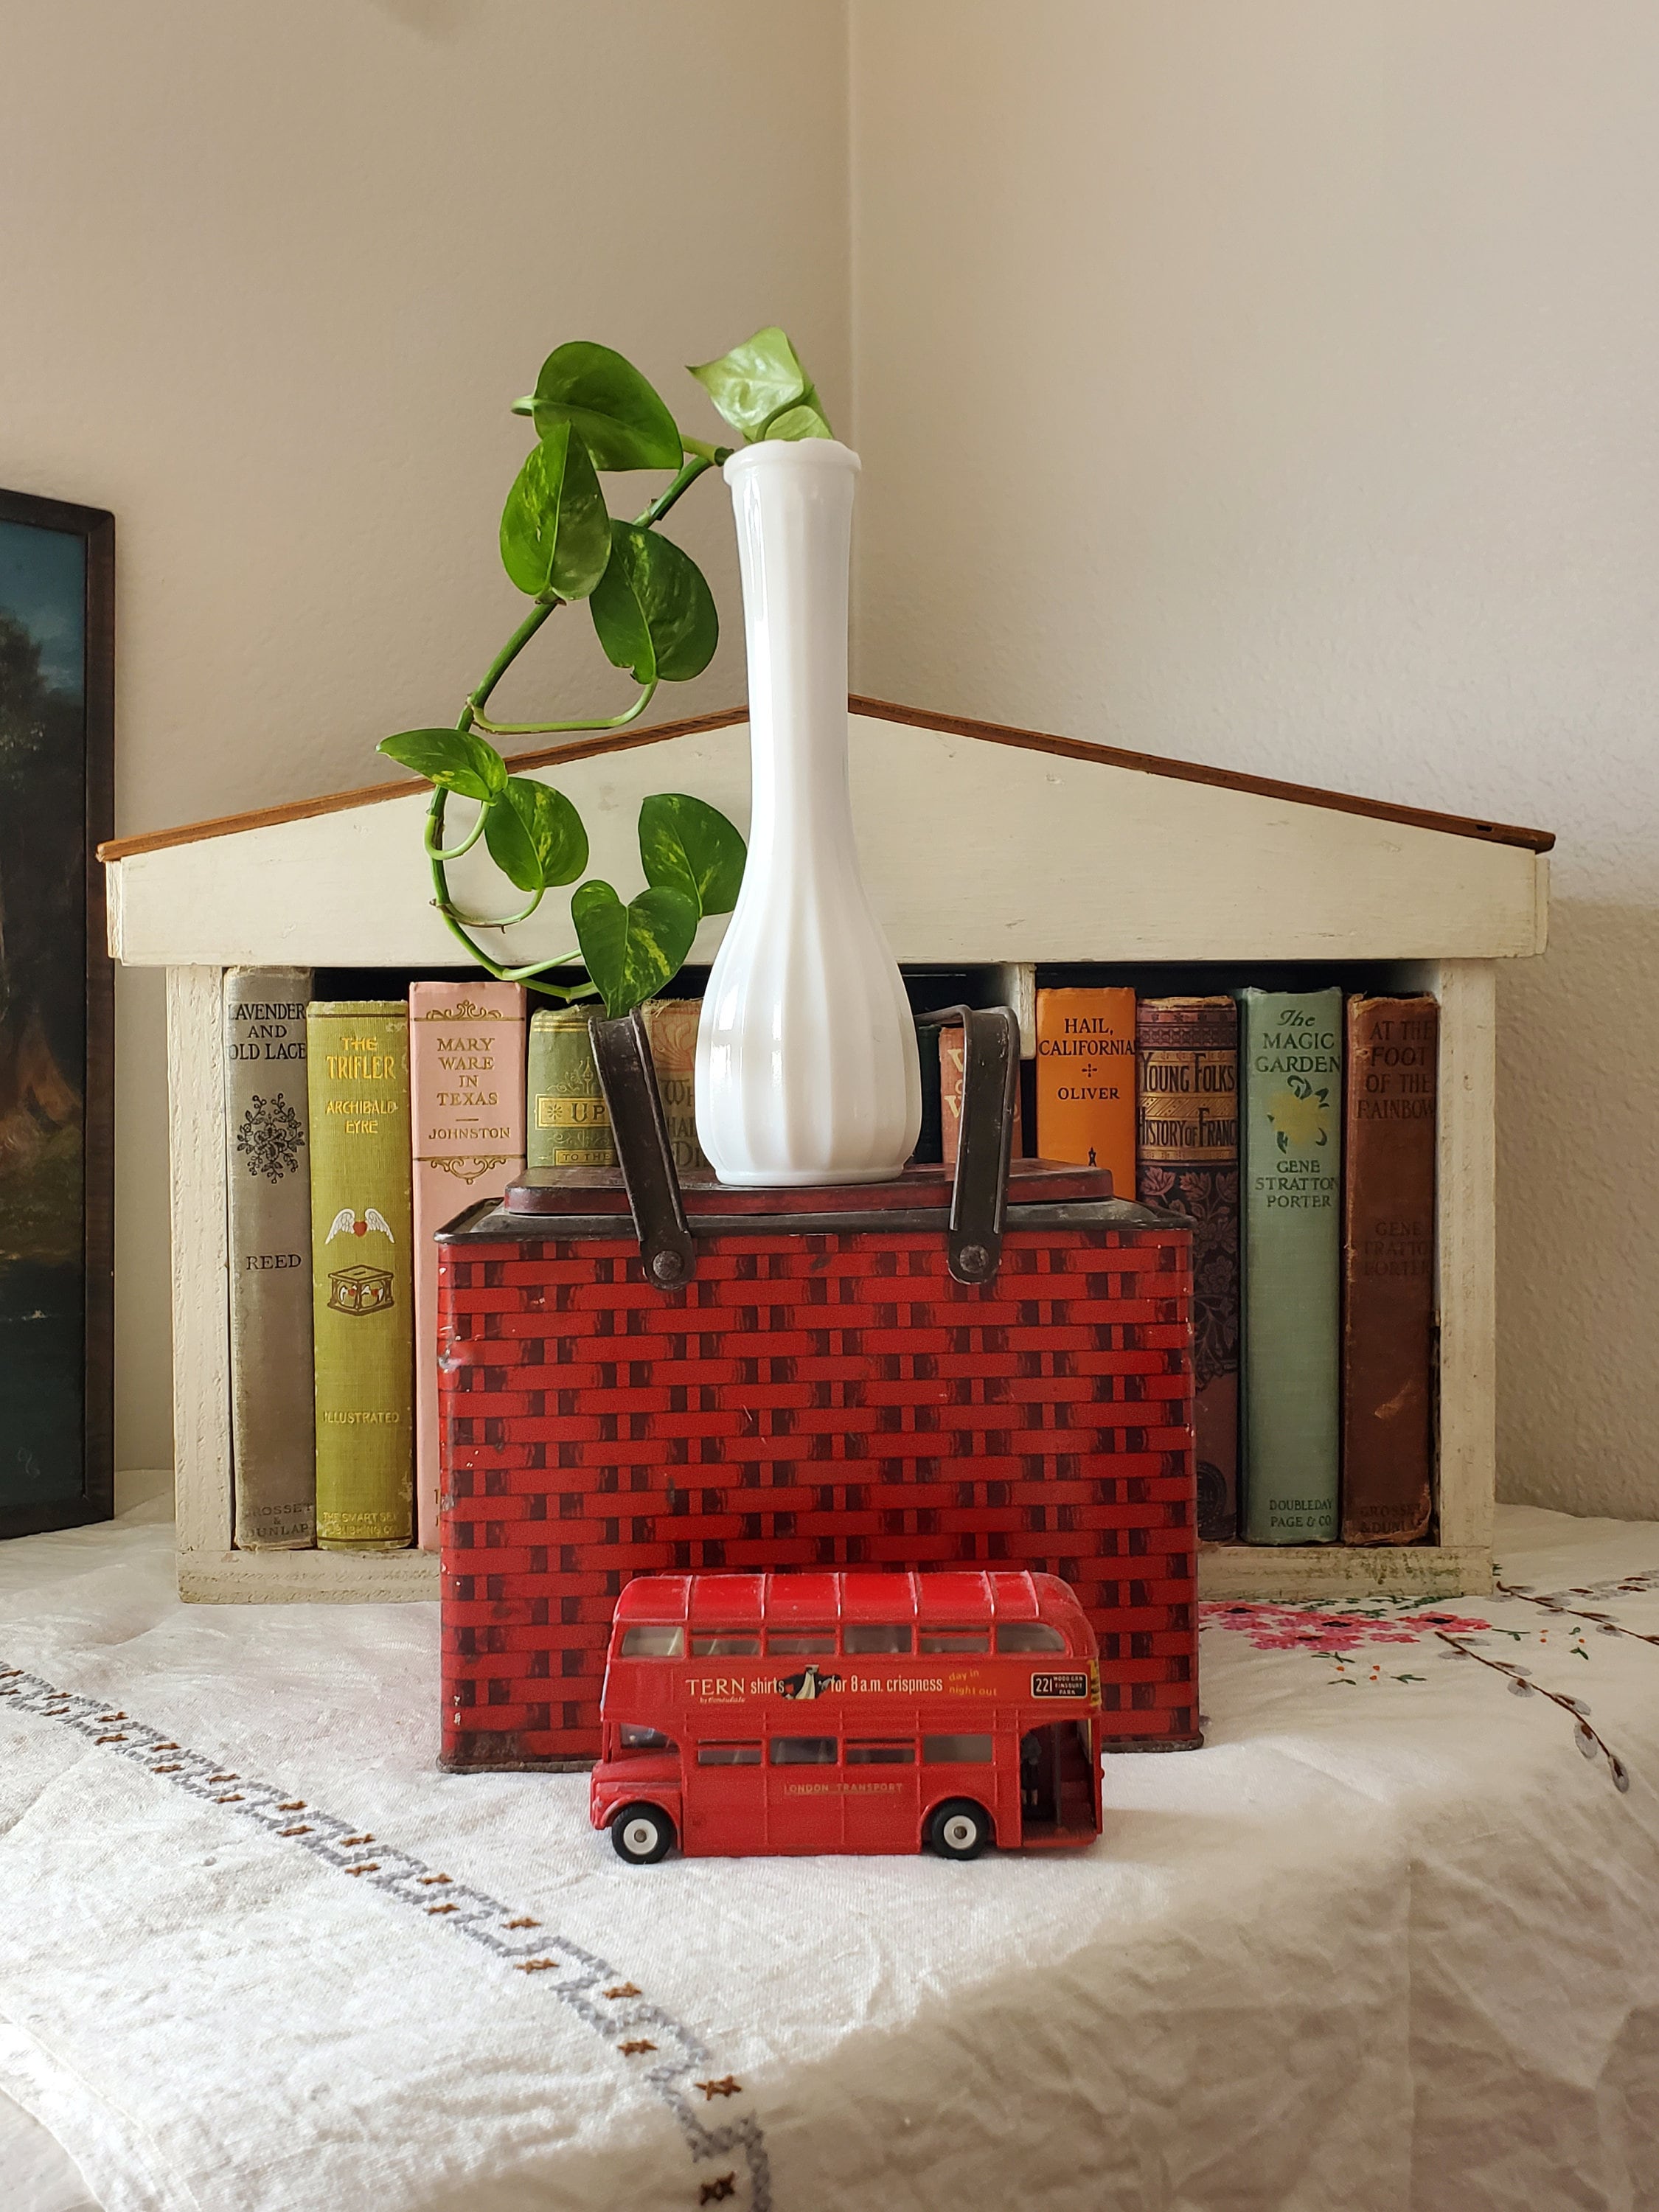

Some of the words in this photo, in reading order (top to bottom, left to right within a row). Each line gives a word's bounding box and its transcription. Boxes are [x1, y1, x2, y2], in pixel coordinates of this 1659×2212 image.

[228, 1004, 307, 1020] LAVENDER
[1277, 1009, 1315, 1026] The
[248, 1025, 287, 1037] AND
[1065, 1018, 1113, 1035] HAIL,
[1369, 1020, 1394, 1040] AT
[1401, 1020, 1433, 1040] THE
[341, 1036, 378, 1051] THE
[437, 1038, 495, 1051] MARY
[1262, 1032, 1335, 1049] MAGIC
[228, 1044, 260, 1060] OLD
[265, 1043, 307, 1060] LACE
[1371, 1047, 1426, 1066] FOOT
[326, 1056, 396, 1079] TRIFLER
[438, 1057, 494, 1070] WARE
[1256, 1056, 1341, 1072] GARDEN
[1141, 1052, 1189, 1093] YOUNG
[459, 1075, 478, 1088] IN
[1366, 1074, 1391, 1093] OF
[1399, 1074, 1431, 1093] THE
[437, 1091, 498, 1106] TEXAS
[1058, 1088, 1120, 1099] OLIVER
[327, 1100, 395, 1114] ARCHIBALD
[1357, 1099, 1435, 1119] RAINBOW
[346, 1120, 378, 1133] EYRE
[428, 1127, 510, 1139] JOHNSTON
[1138, 1107, 1186, 1147] HISTORY
[1198, 1107, 1237, 1147] FRANC
[1276, 1160, 1321, 1173] GENE
[1267, 1195, 1332, 1208] PORTER
[1375, 1221, 1422, 1236] GENE
[246, 1254, 302, 1270] REED
[323, 1411, 399, 1424] ILLUSTRATED
[1269, 1499, 1333, 1510] DOUBLEDAY
[1270, 1516, 1303, 1527] PAGE
[1307, 1516, 1315, 1527] &
[948, 1672, 967, 1681] day
[970, 1669, 980, 1677] in
[685, 1677, 745, 1695] TERN
[751, 1677, 785, 1694] shirts
[830, 1675, 847, 1692] for
[886, 1675, 943, 1695] crispness
[949, 1684, 976, 1696] night
[979, 1688, 997, 1696] out
[1035, 1678, 1052, 1692] 221
[785, 1784, 829, 1793] LONDON
[837, 1783, 903, 1792] TRANSPORT
